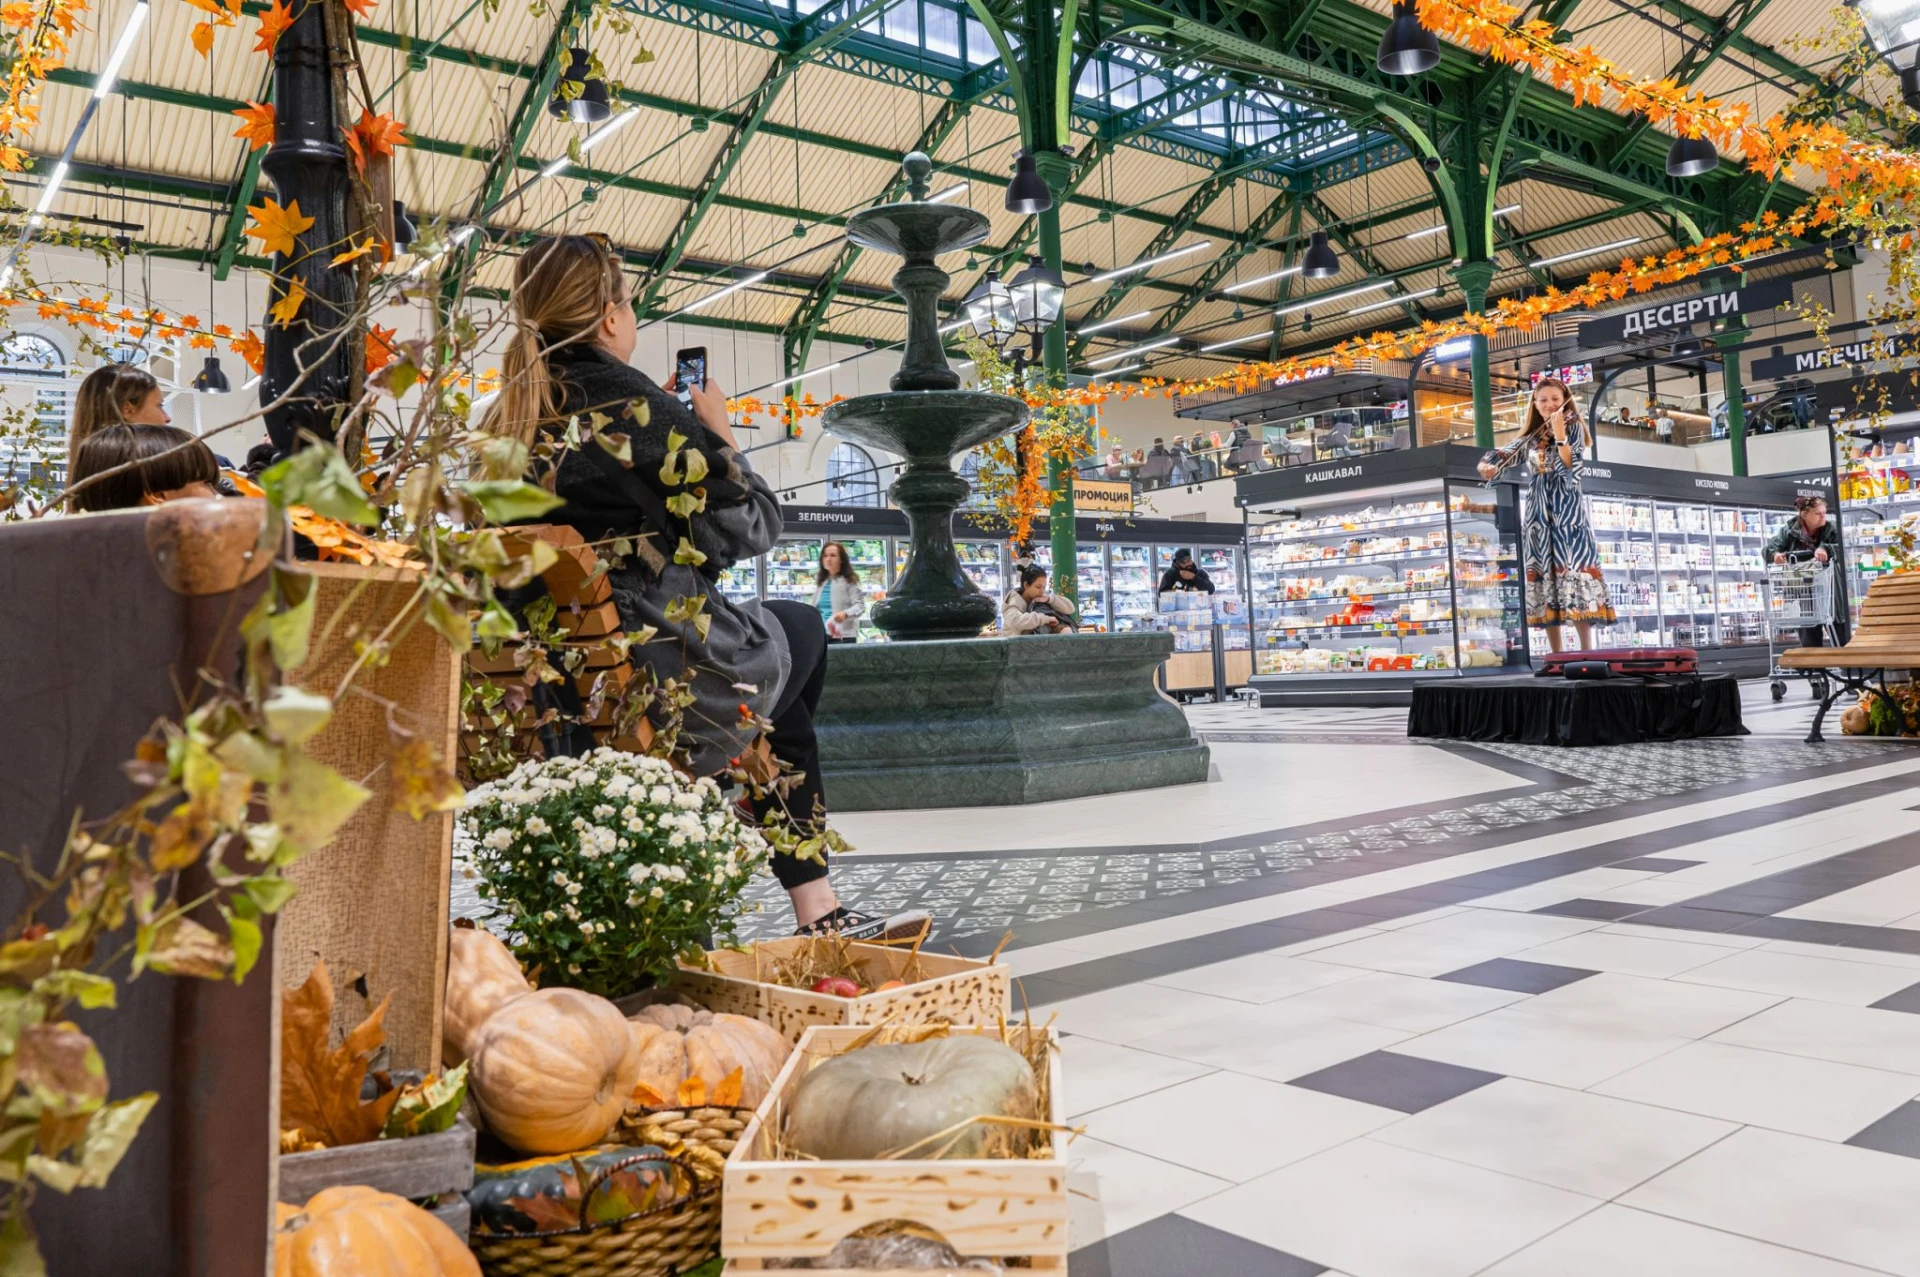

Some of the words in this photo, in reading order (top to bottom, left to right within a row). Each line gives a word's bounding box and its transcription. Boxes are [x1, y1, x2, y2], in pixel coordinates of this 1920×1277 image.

[1623, 291, 1739, 338] ДЕСЕРТИ
[1305, 466, 1362, 483] КАШКАВАЛ
[1074, 490, 1129, 503] ПРОМОЦИЯ
[798, 512, 854, 524] ЗЕЛЕНЧУЦИ
[1095, 524, 1115, 532] РИБА
